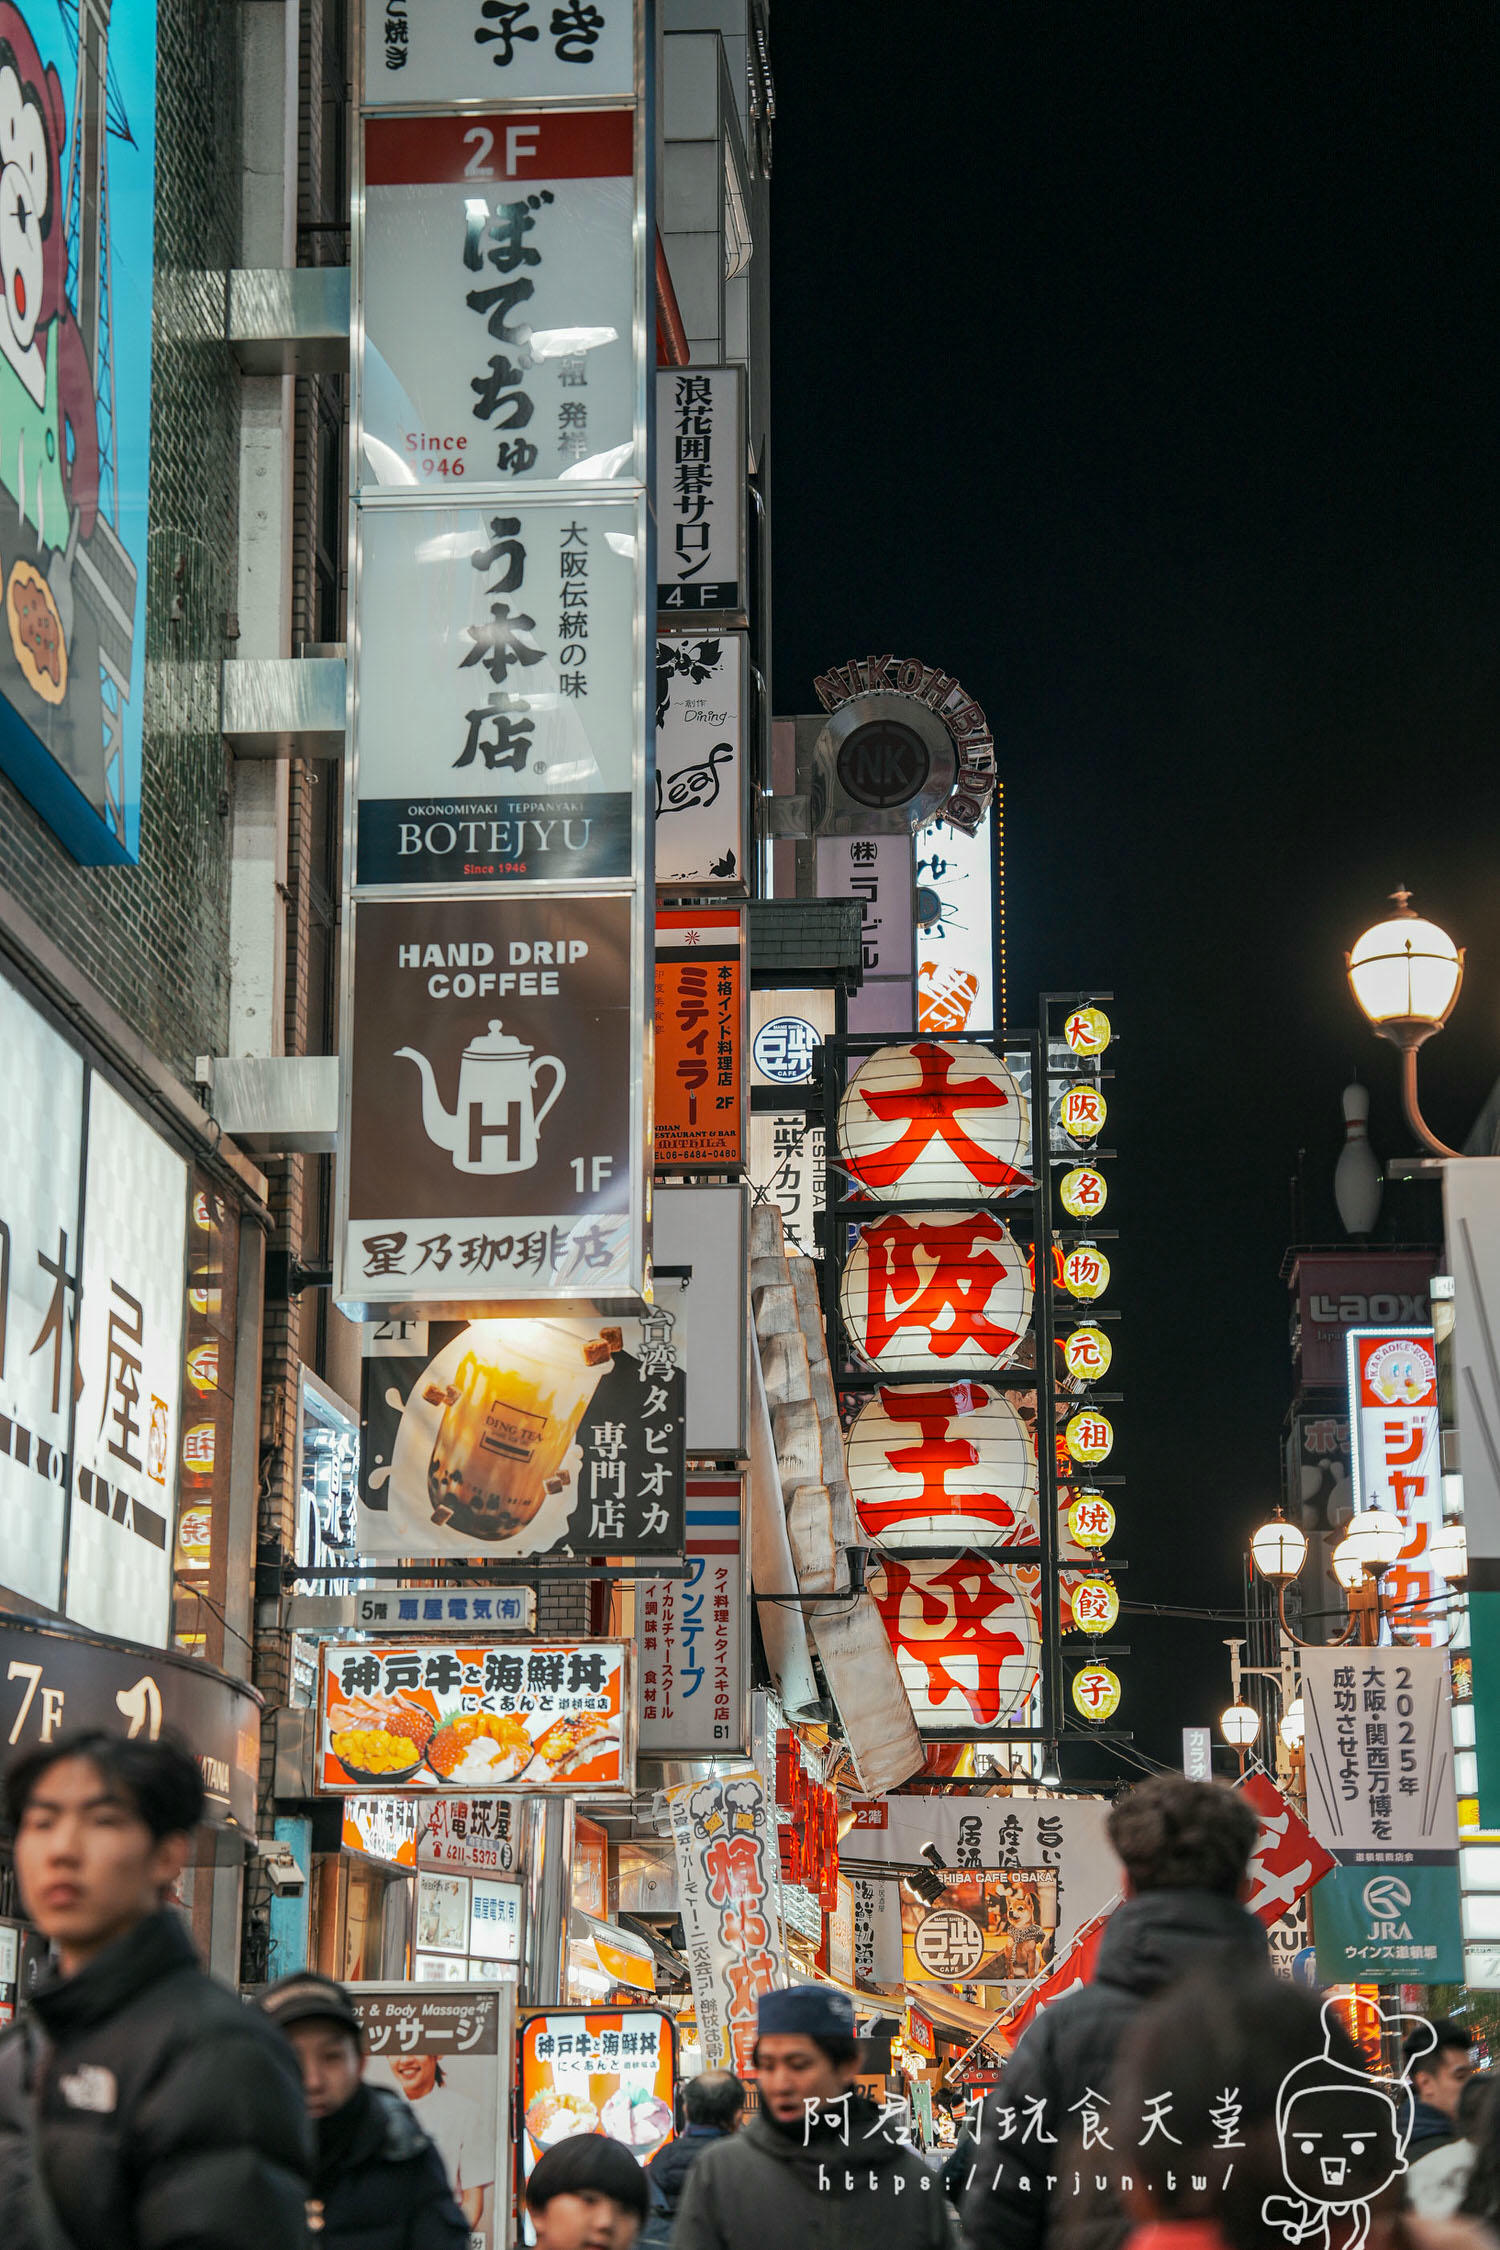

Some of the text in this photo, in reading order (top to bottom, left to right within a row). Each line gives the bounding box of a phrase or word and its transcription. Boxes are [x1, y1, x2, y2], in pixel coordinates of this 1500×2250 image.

[463, 125, 540, 177] 2F
[406, 433, 467, 451] Since
[674, 374, 714, 581] 浪花囲碁サロン
[559, 521, 588, 699] 大阪伝統の味
[685, 709, 728, 727] Dining
[407, 801, 585, 817] OKONOMIYAKI TEPPANYAKI
[397, 818, 593, 858] BOTEJYU
[463, 861, 527, 875] Since 1946
[399, 940, 590, 969] HAND DRIP
[428, 972, 560, 999] COFFEE
[717, 965, 733, 1087] 本格インド料理店
[716, 1096, 734, 1110] 2F
[718, 1129, 737, 1137] BAR
[570, 1155, 613, 1193] 1F
[362, 1223, 621, 1279] 星乃珈琲店
[1310, 1294, 1428, 1323] Laox
[485, 1415, 518, 1435] DING
[520, 1427, 543, 1443] TEA
[637, 1305, 677, 1539] 台湾タピオカ
[588, 1421, 627, 1539] 専門店
[361, 1598, 521, 1620] 5階 扇屋電気(有)
[713, 1567, 730, 1722] タイ料理とタイスキの店
[341, 1652, 607, 1697] 神戸牛と海鮮丼
[644, 1670, 657, 1720] 食材店
[714, 1725, 729, 1739] B1
[1333, 1665, 1360, 1801] 成功させよう
[1395, 1666, 1420, 1796] 2025年
[1189, 1730, 1208, 1780] カラオ
[1362, 1665, 1393, 1841] 大阪・関西万博を
[857, 1809, 883, 1825] 2階
[975, 1872, 1008, 1883] CAFE
[1012, 1871, 1054, 1883] OSAKA
[1367, 1921, 1414, 1940] JRA
[369, 2004, 380, 2016] &
[386, 2004, 417, 2019] Body
[422, 2004, 475, 2018] Massage
[476, 2001, 495, 2014] 4F
[356, 2016, 487, 2053] ッサージ
[537, 2031, 657, 2058] 神戸牛と海鮮丼
